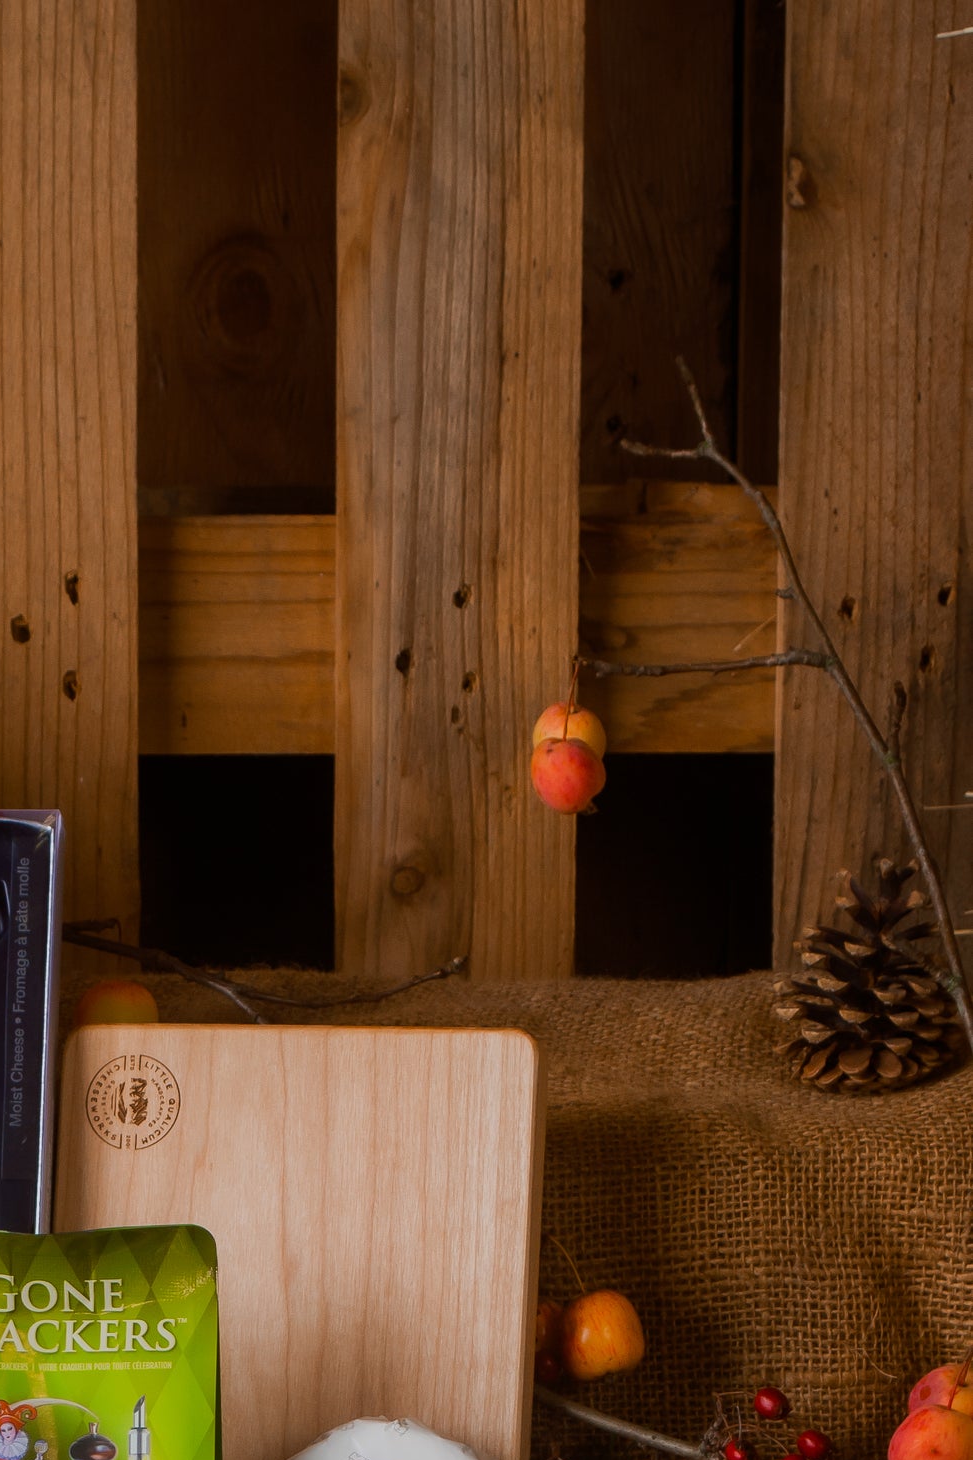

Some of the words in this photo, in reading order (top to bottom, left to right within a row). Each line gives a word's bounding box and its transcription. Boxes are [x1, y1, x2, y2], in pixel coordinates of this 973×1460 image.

[18, 857, 30, 897] molle
[15, 899, 31, 931] pâte
[15, 936, 27, 946] à
[12, 949, 30, 1013] Fromage
[11, 1029, 25, 1083] Cheese
[144, 1061, 173, 1090] LITTLE
[9, 1087, 23, 1127] Moist
[91, 1064, 120, 1141] CHEESEWORKS
[141, 1098, 176, 1145] QUALICUM
[94, 1361, 111, 1371] POUR
[112, 1361, 131, 1370] TOUTE
